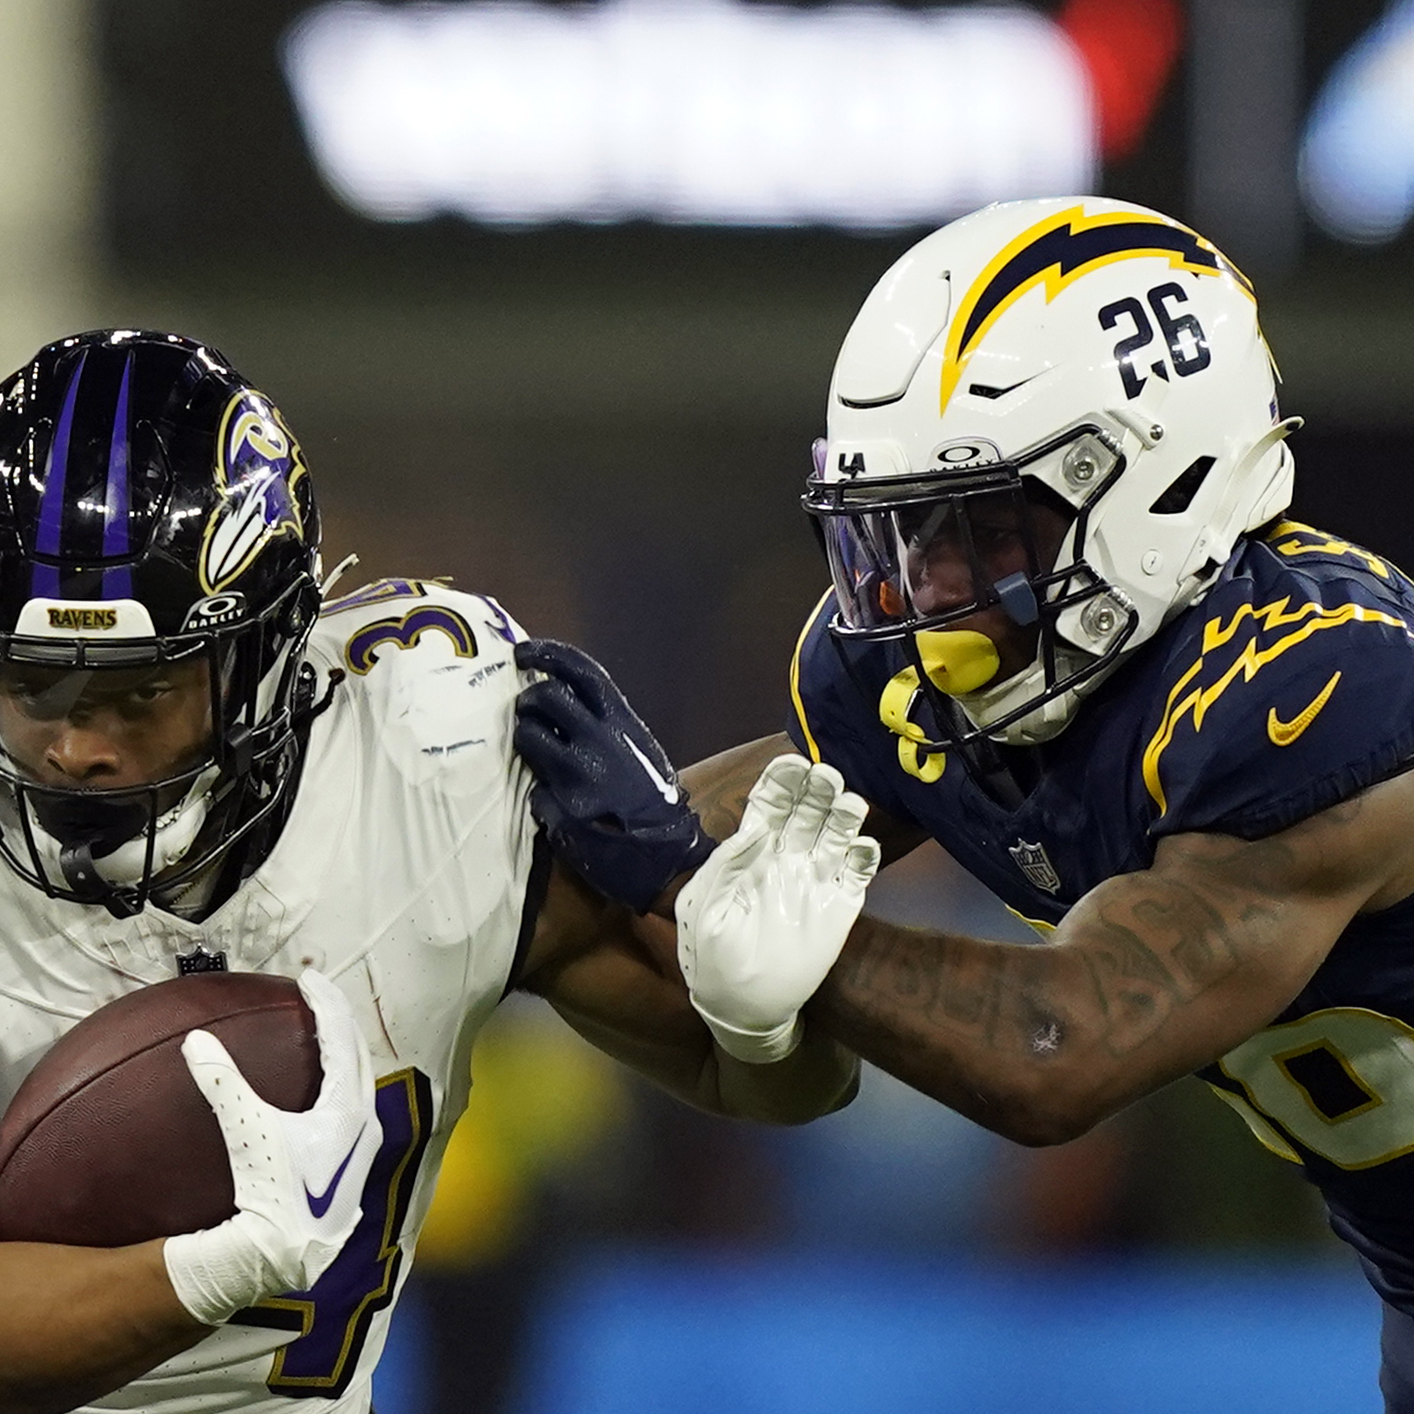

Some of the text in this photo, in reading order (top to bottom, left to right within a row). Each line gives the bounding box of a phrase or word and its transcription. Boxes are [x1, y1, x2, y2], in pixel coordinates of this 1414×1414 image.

[1098, 281, 1212, 400] 26
[838, 452, 866, 479] LA
[47, 608, 117, 631] RAVENS
[188, 608, 244, 629] OAKLEY
